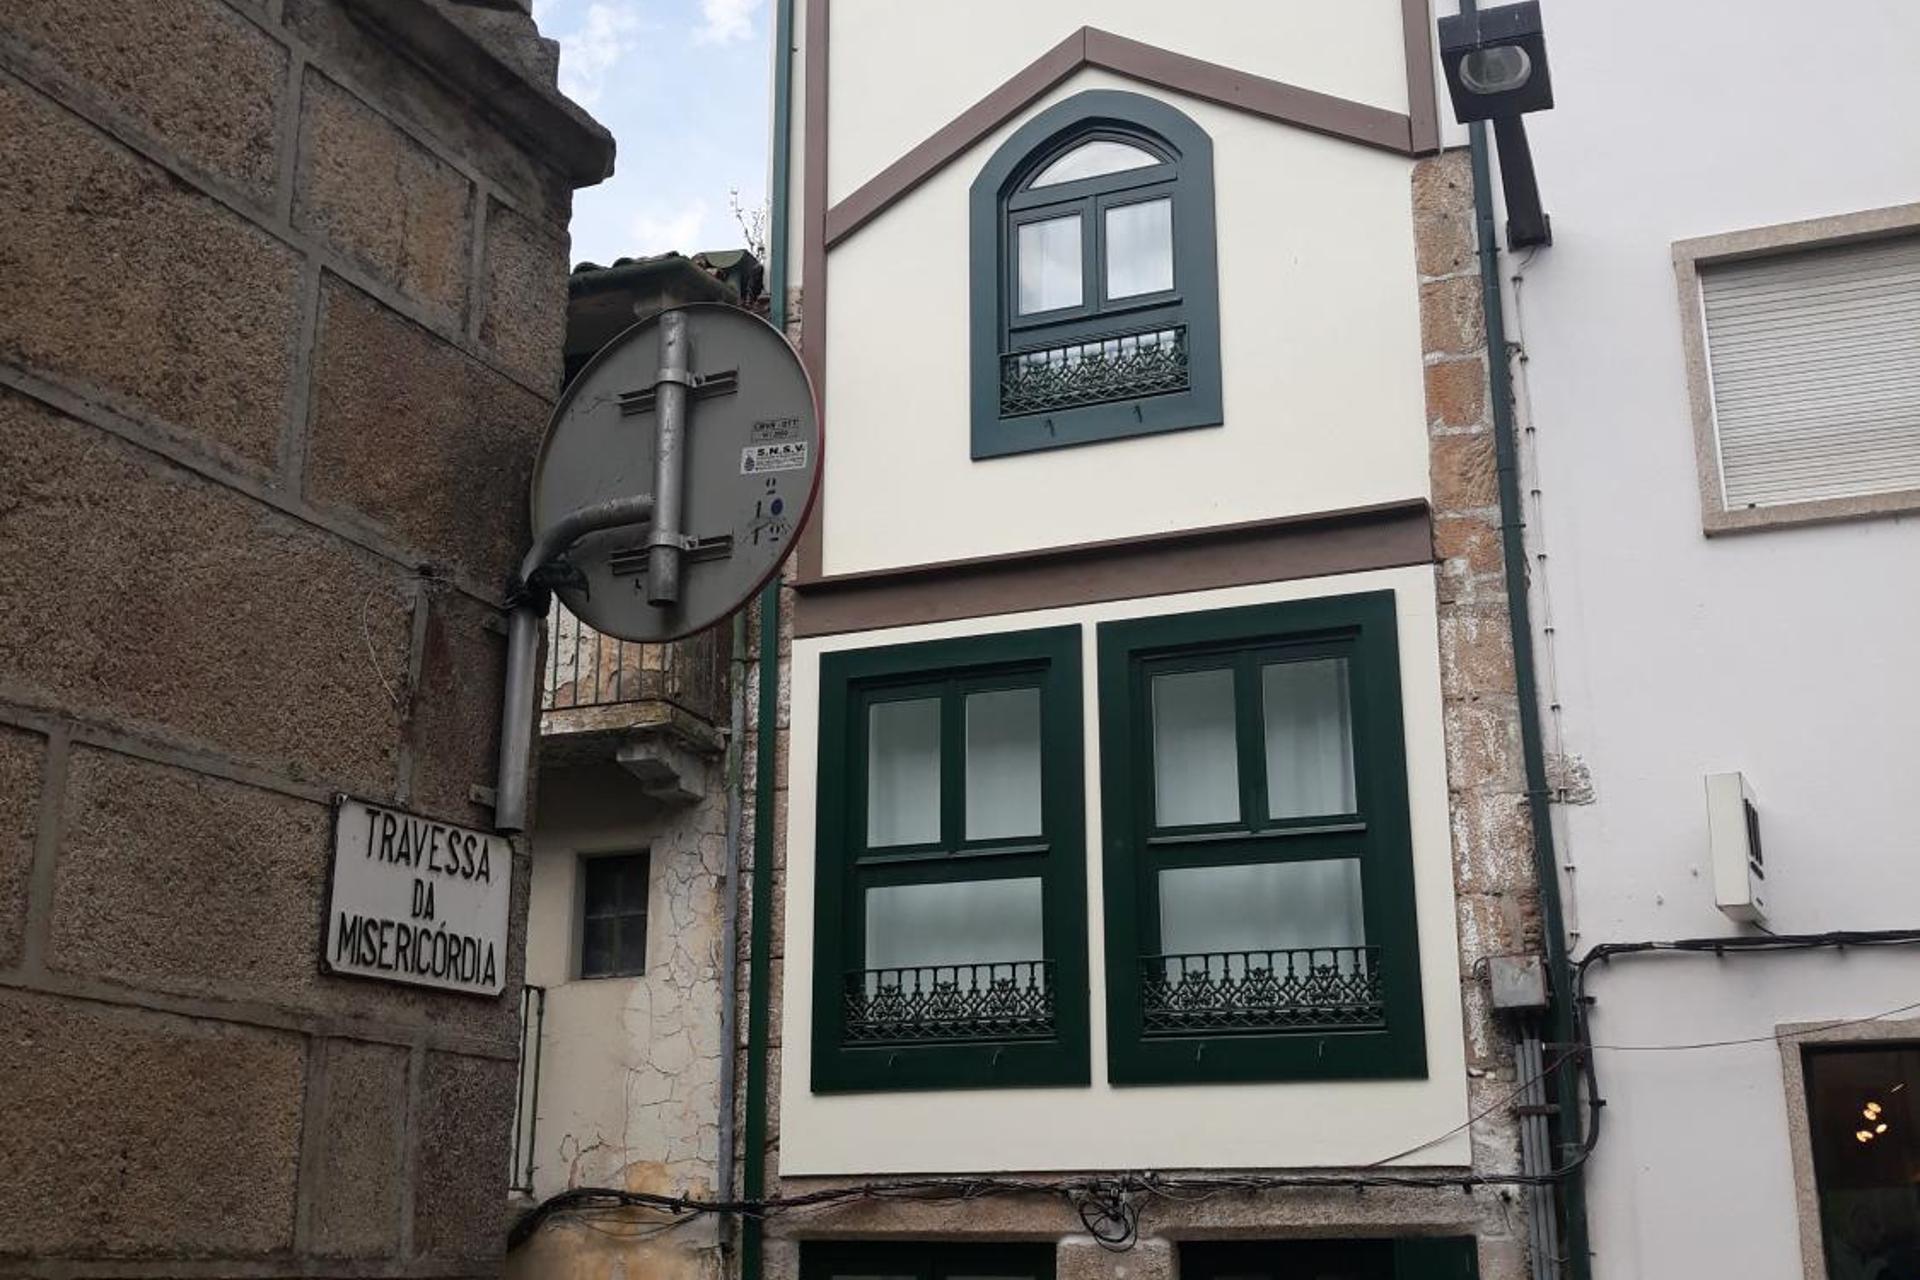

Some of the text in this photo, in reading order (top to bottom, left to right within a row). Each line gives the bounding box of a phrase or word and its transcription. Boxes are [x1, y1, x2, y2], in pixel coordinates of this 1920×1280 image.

[366, 808, 490, 883] TRAVESSA
[411, 878, 434, 920] DA
[337, 912, 495, 986] MISERICÓRDIA
